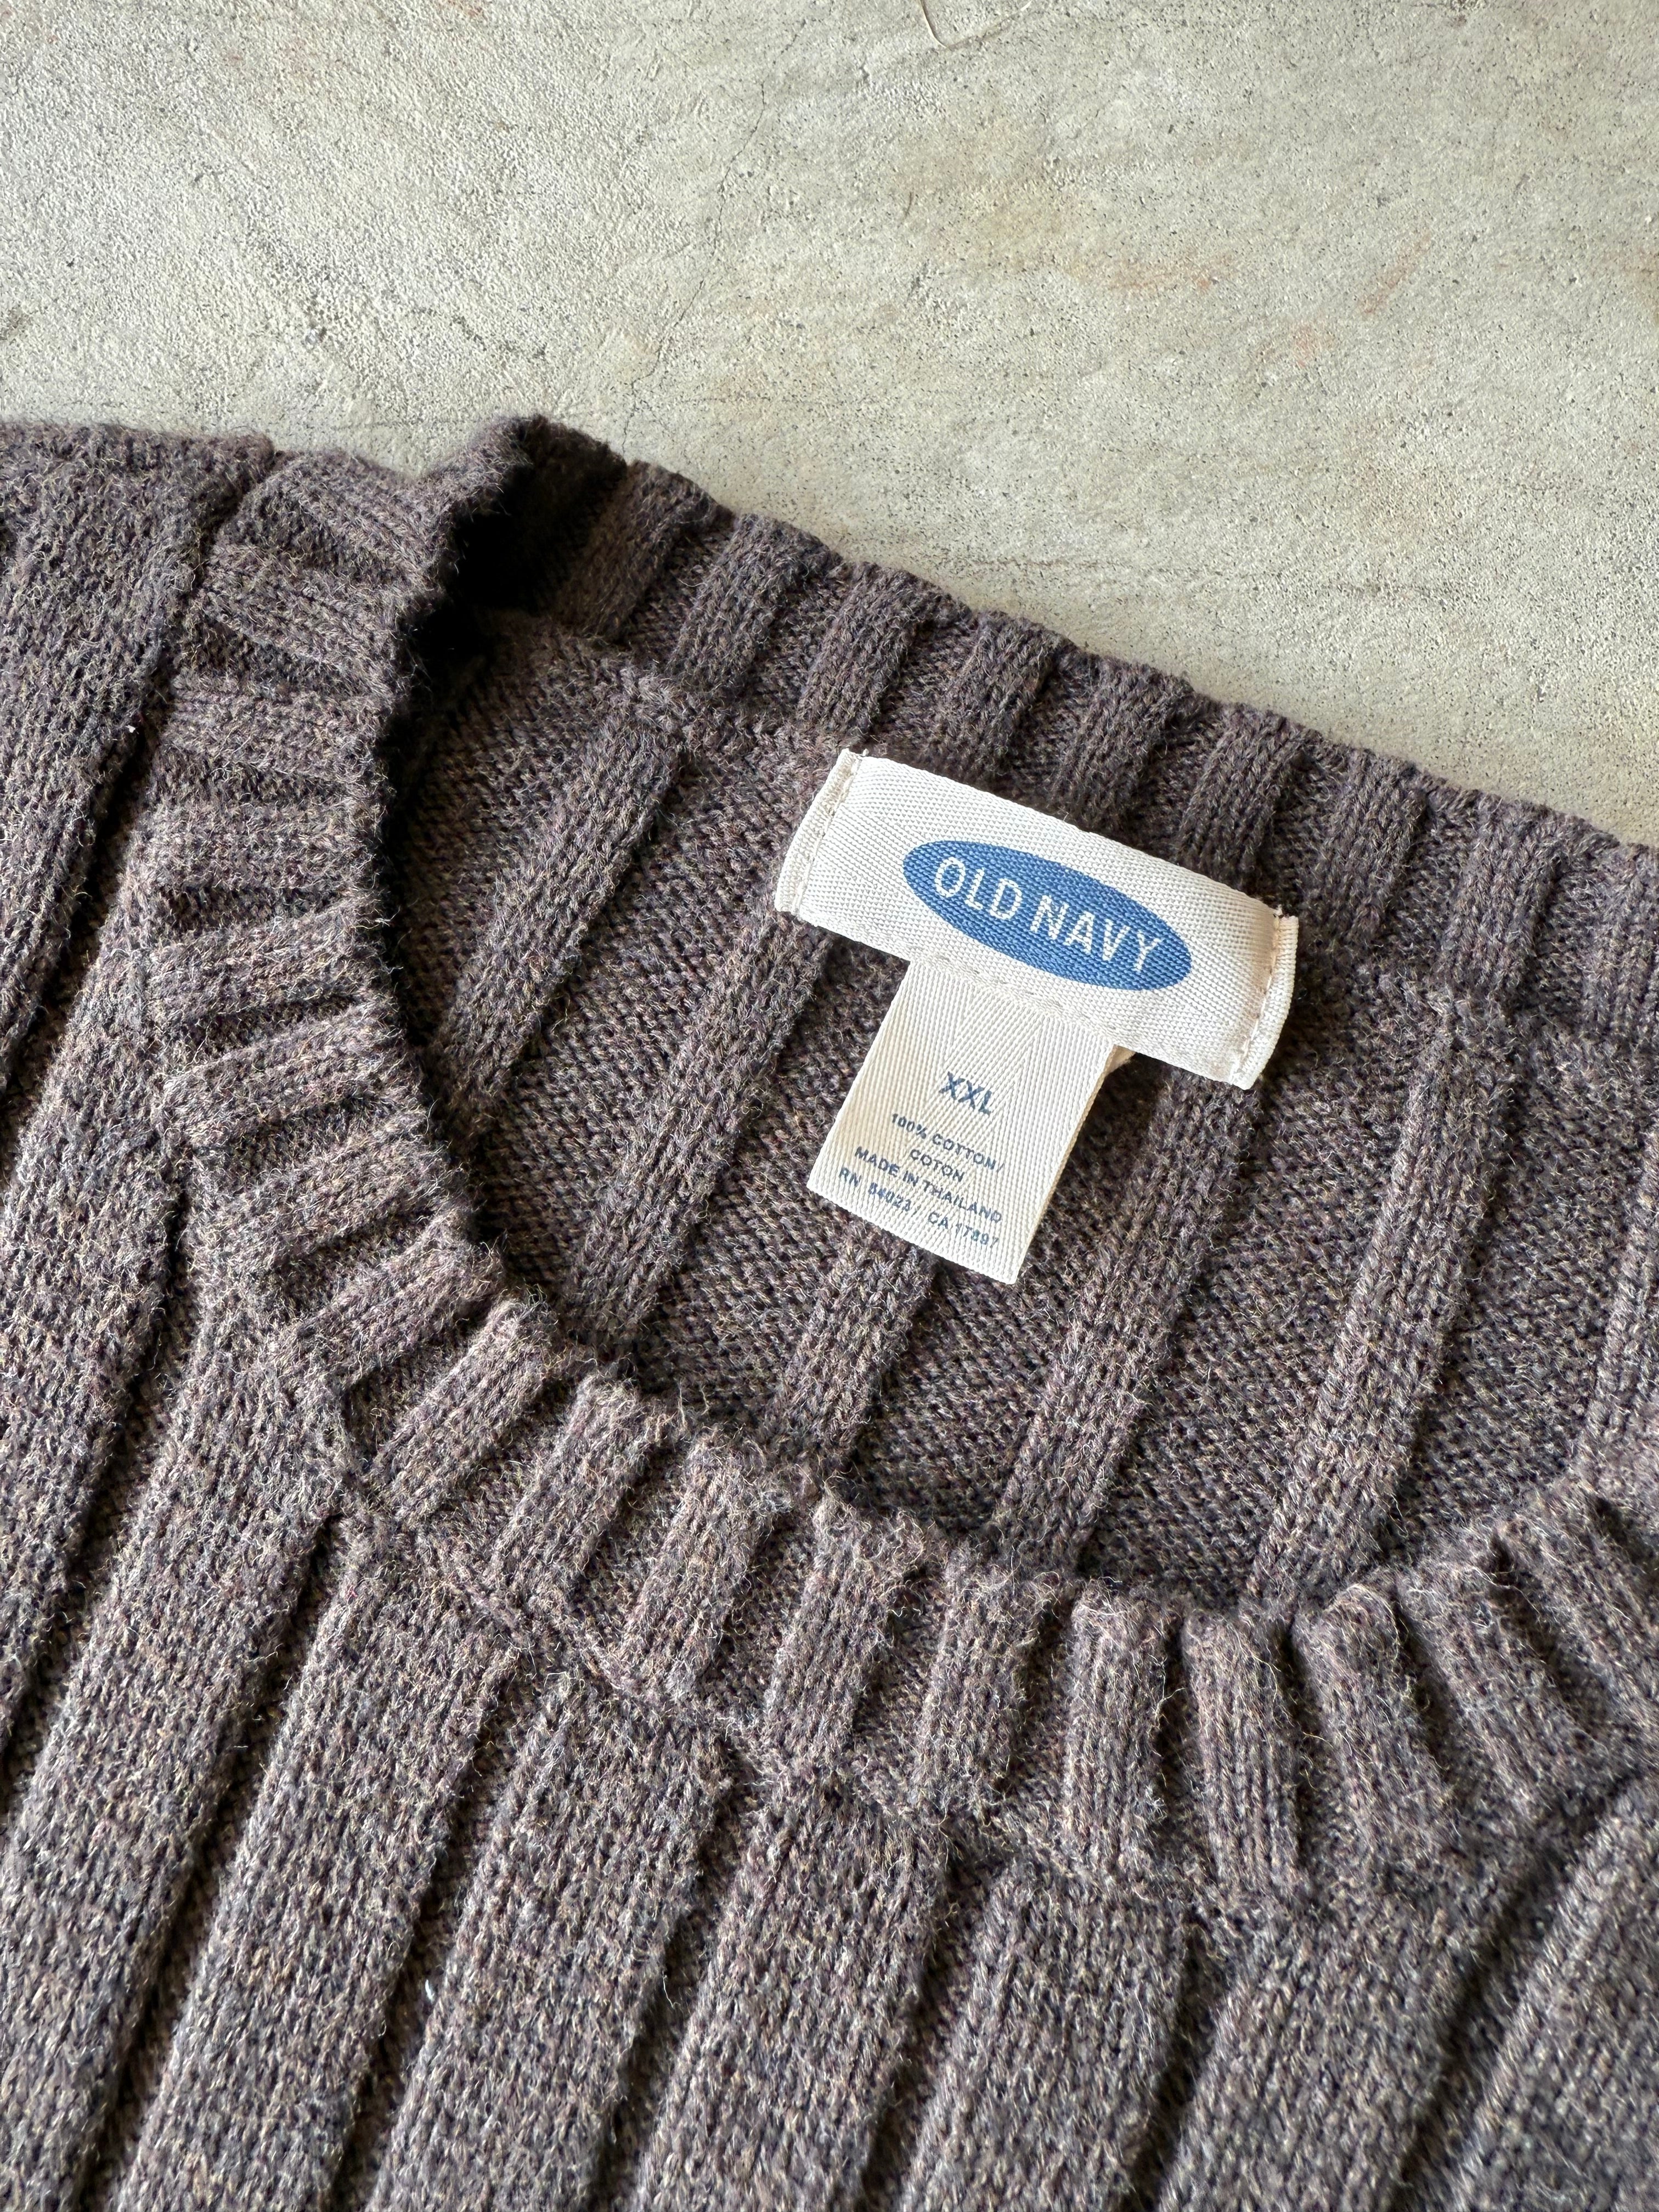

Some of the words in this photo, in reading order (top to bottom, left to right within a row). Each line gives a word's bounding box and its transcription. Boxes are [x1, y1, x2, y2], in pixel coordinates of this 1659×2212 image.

[934, 856, 1023, 920] OLD
[1030, 893, 1165, 972] NAVY
[939, 1071, 992, 1115] XXL
[891, 1112, 927, 1139] 100%
[855, 1147, 900, 1178] MADE
[903, 1169, 919, 1187] IN
[922, 1180, 1002, 1223] THAILAND
[910, 1149, 964, 1182] COTON
[839, 1167, 861, 1187] RN
[928, 1212, 949, 1230] CA
